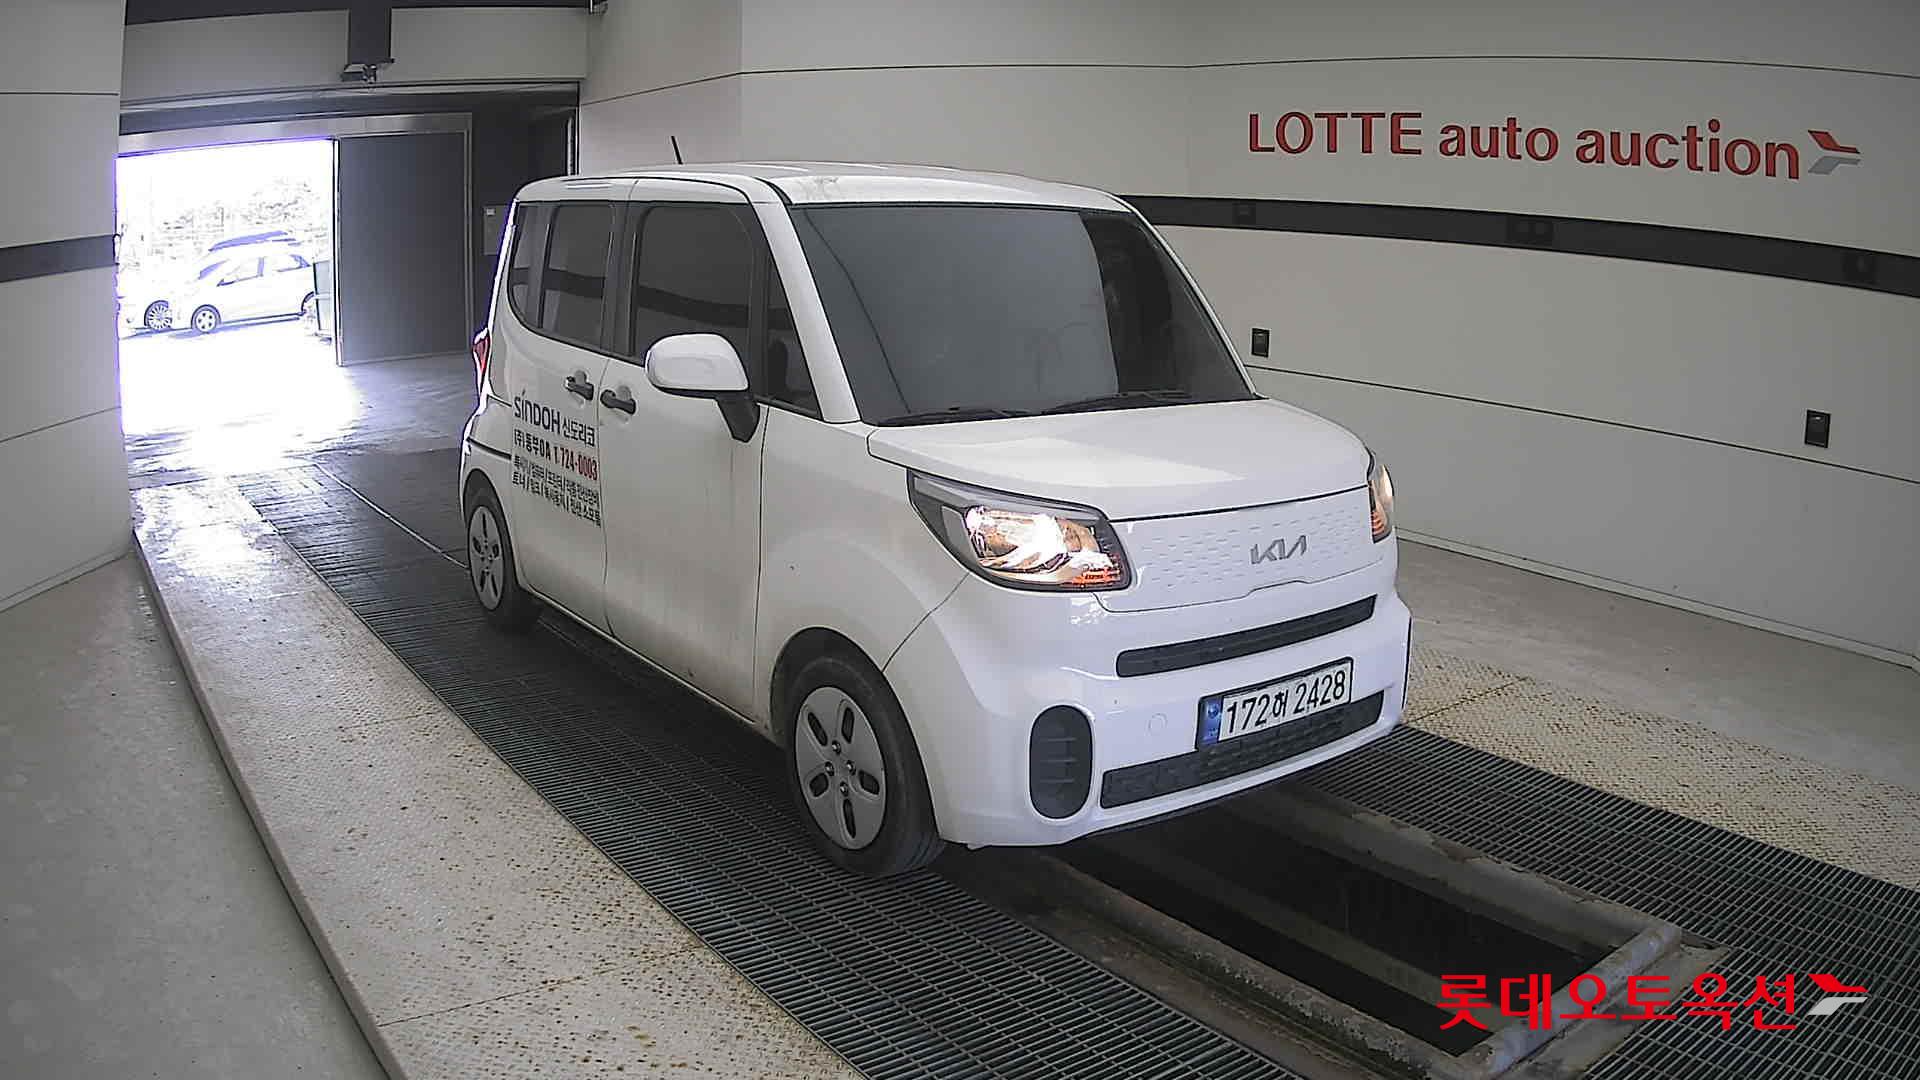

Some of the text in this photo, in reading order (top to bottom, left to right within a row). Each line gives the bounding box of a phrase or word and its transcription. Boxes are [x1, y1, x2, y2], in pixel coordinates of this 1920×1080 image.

[1248, 112, 1800, 180] LOTTE auto auction
[562, 417, 595, 447] 신도리코
[1250, 535, 1306, 564] KIA
[1293, 670, 1346, 714] 2428
